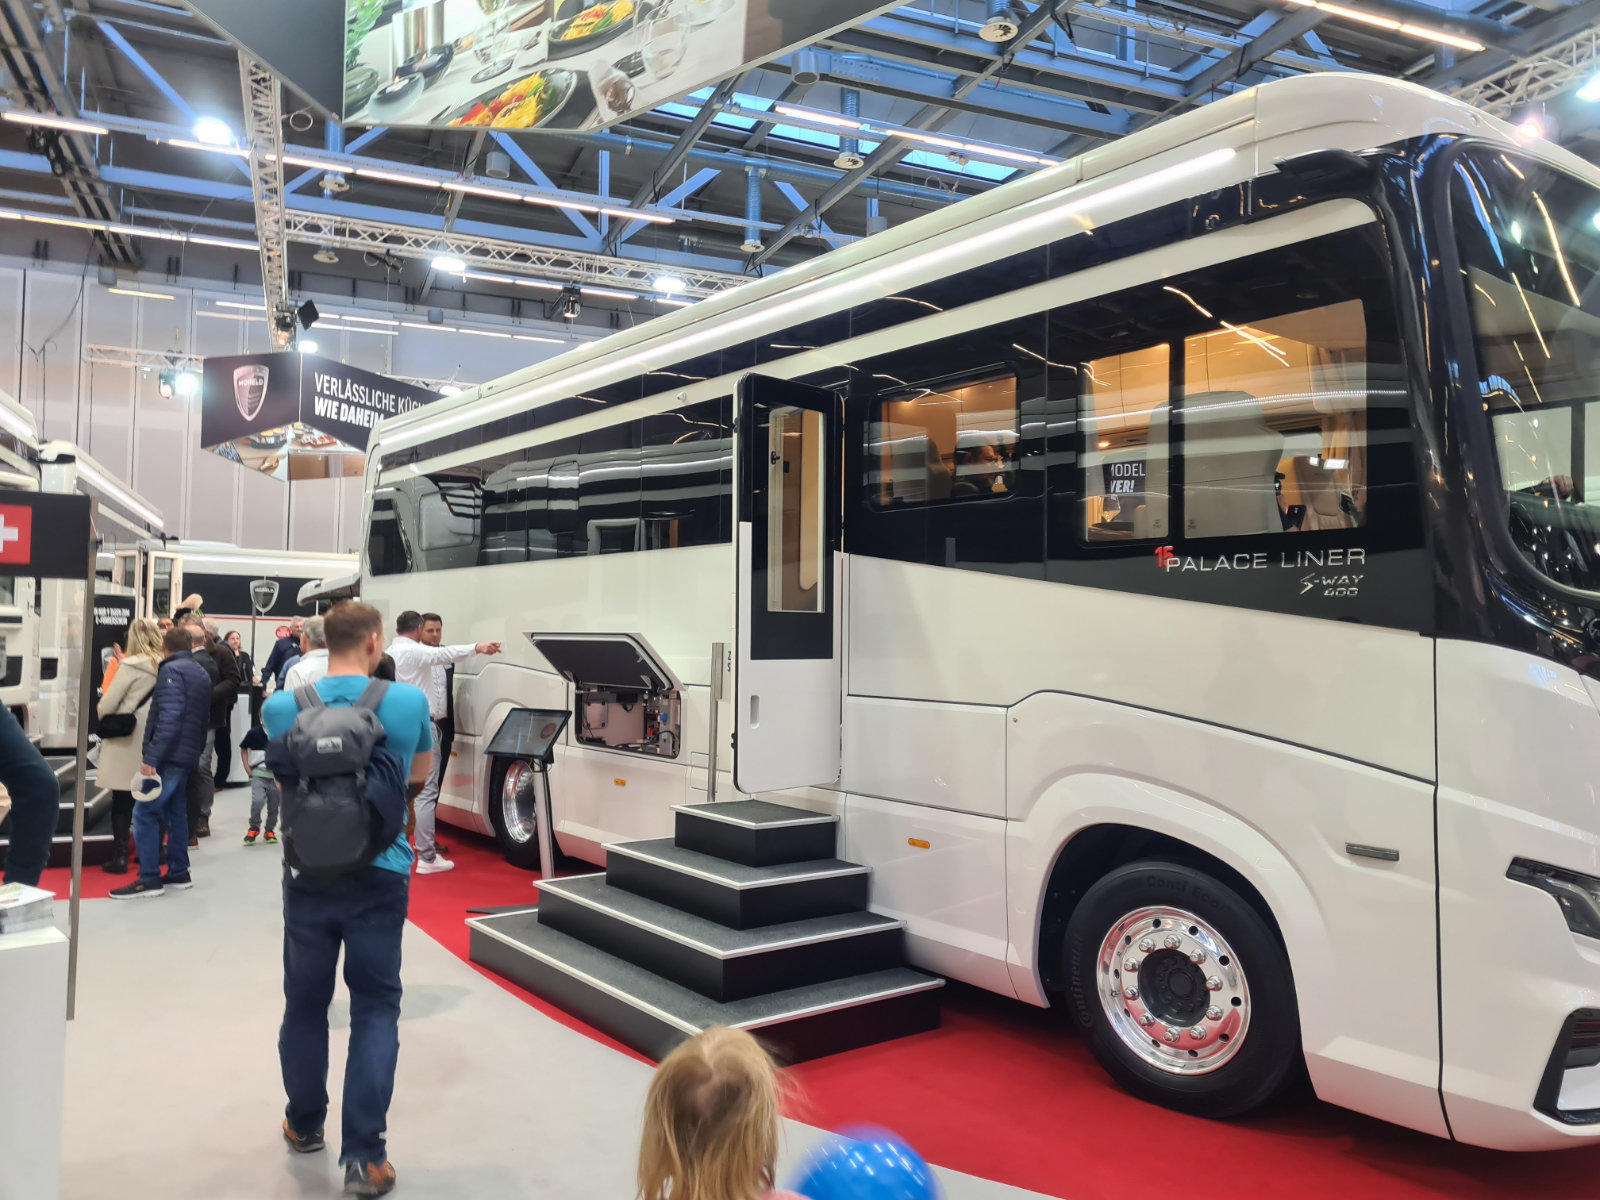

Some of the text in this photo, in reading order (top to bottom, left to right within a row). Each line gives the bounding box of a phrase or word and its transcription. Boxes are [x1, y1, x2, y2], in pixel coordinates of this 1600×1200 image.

[314, 371, 396, 413] VERLÄSSLICHE
[314, 395, 340, 420] WIE
[1166, 548, 1366, 573] PALACE LINER
